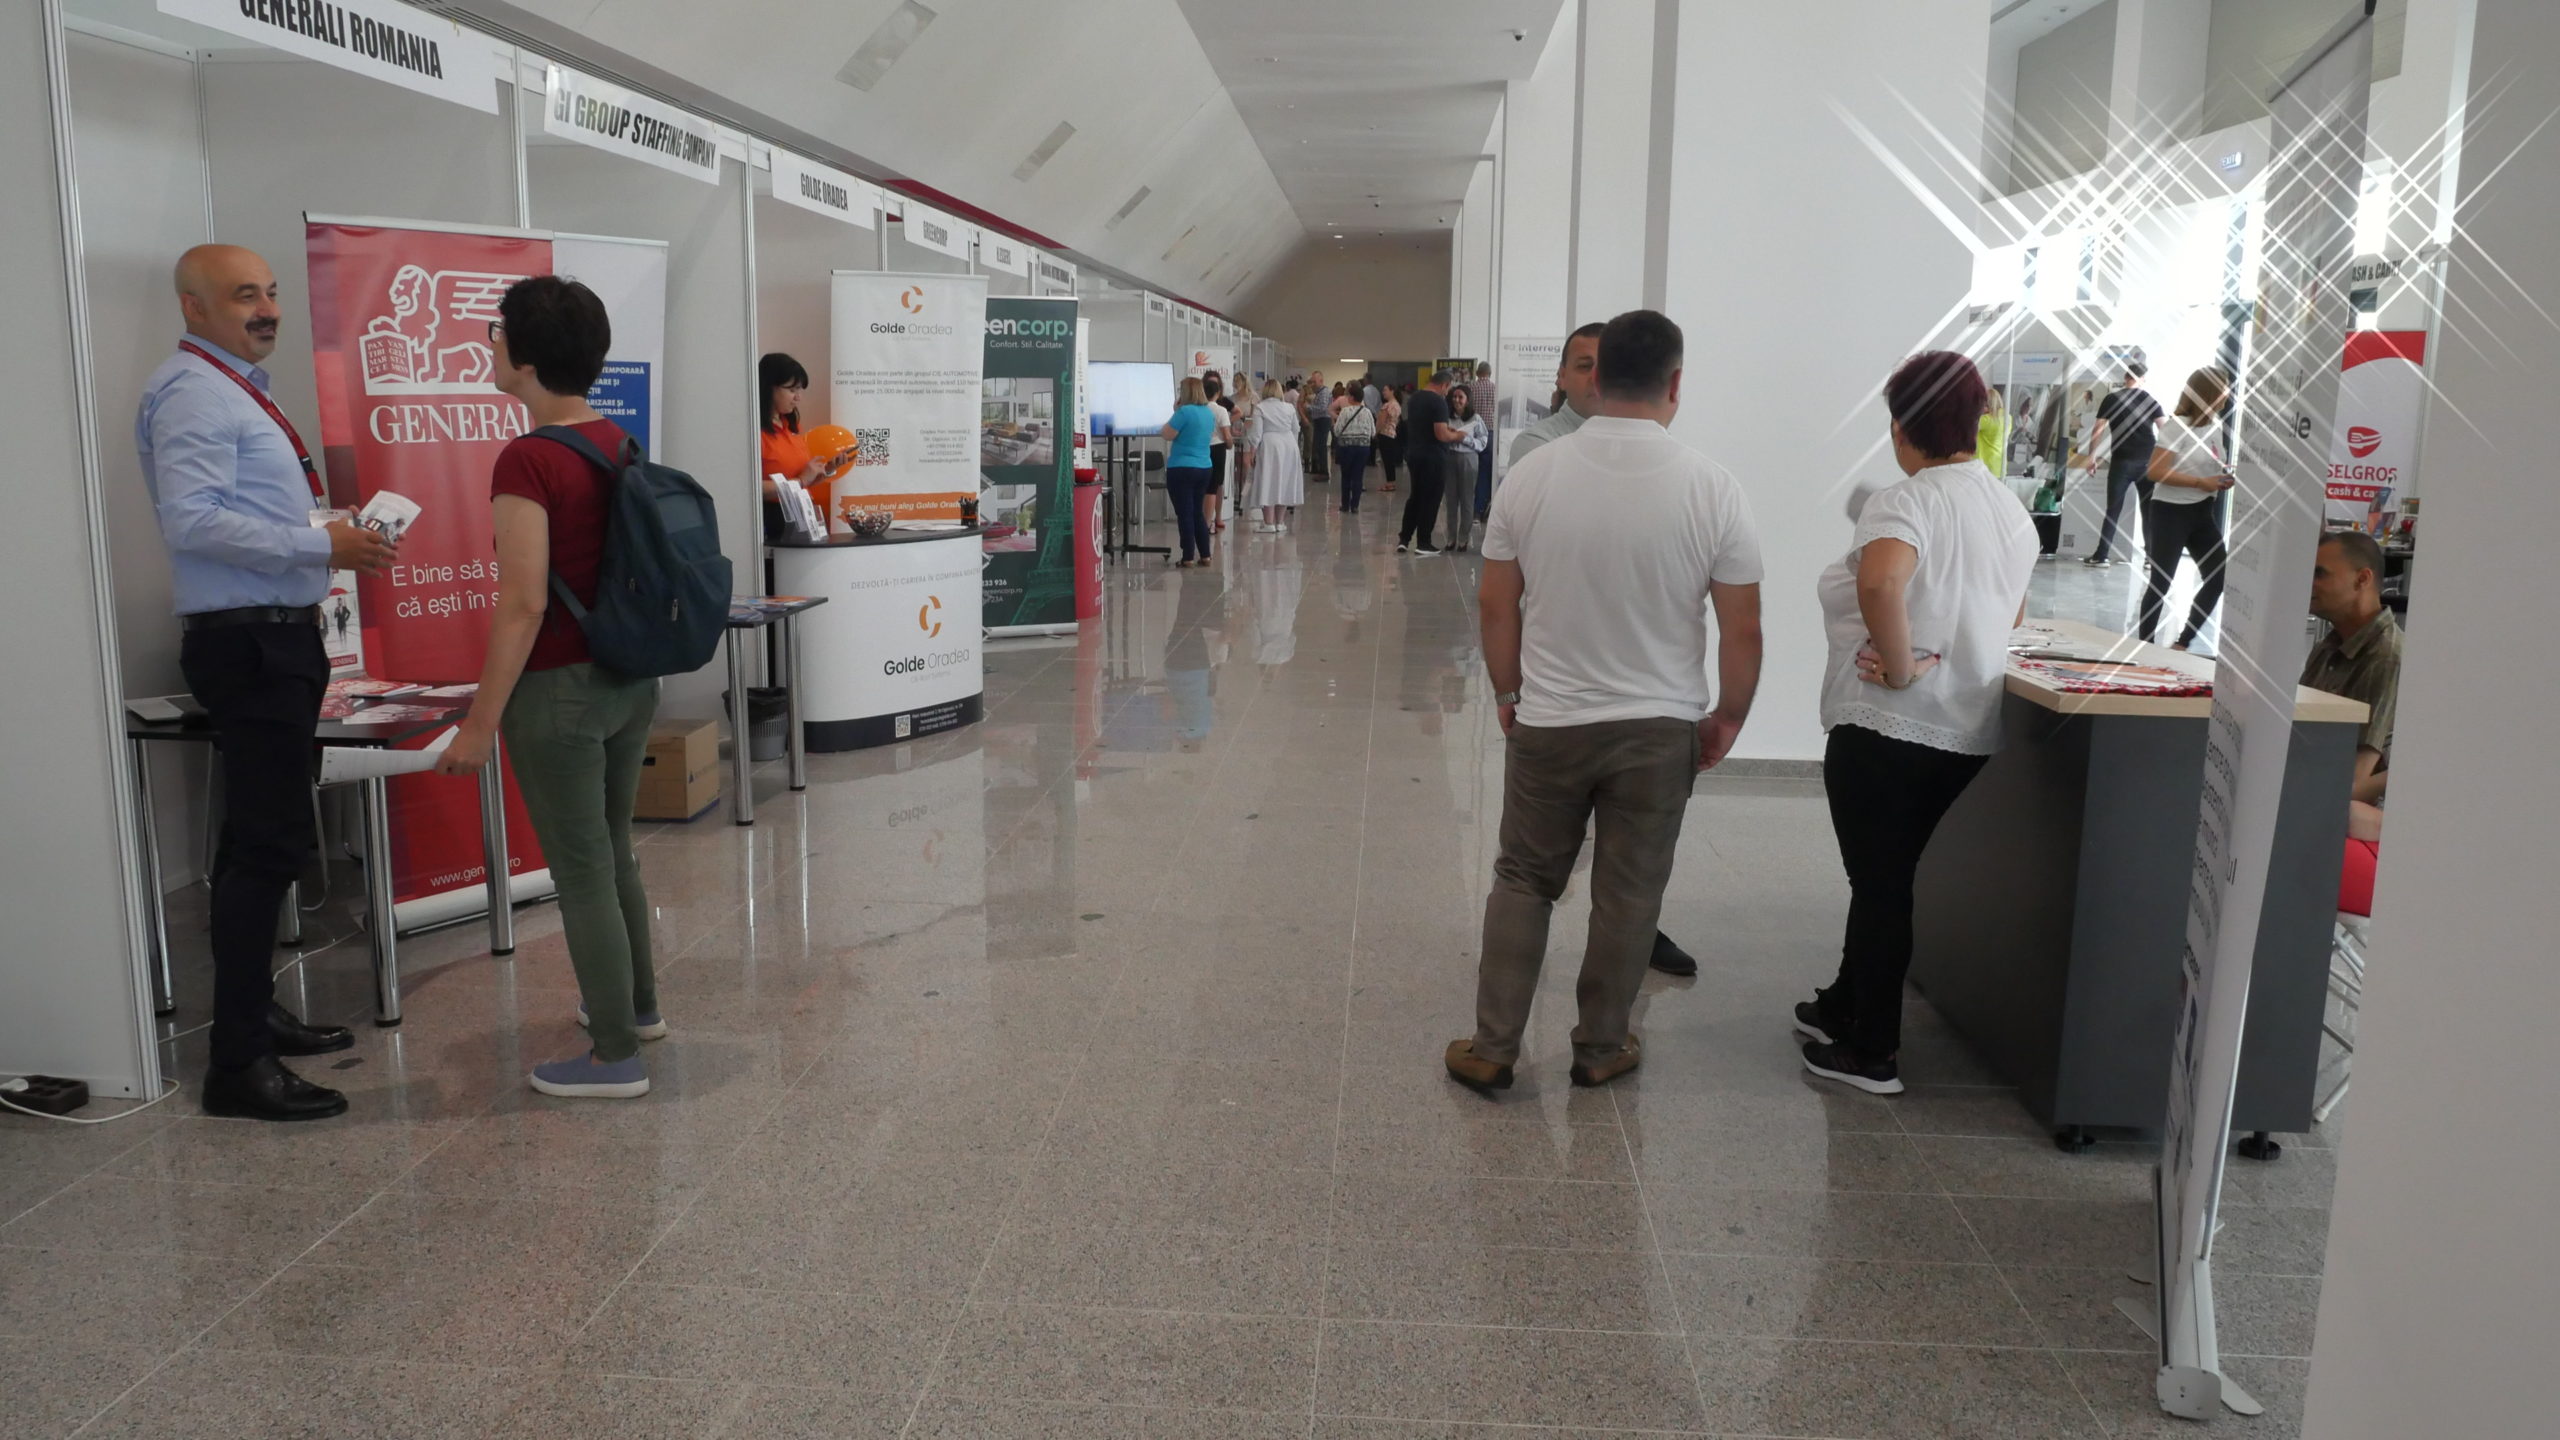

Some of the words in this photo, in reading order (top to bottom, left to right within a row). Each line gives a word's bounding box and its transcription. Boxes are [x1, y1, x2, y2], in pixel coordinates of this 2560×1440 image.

[349, 11, 443, 80] ROMANIA
[553, 87, 572, 123] GI
[574, 94, 631, 139] GROUP
[631, 113, 684, 158] STAFFING
[682, 131, 717, 170] COMPANY
[800, 172, 822, 202] GOLDE
[823, 181, 849, 211] ORADEA
[923, 220, 948, 247] GREENCORP
[2352, 265, 2368, 282] ASH
[870, 322, 905, 334] Golde
[908, 323, 953, 335] Oradea
[990, 340, 1019, 348] Confort.
[2327, 463, 2397, 481] SELGROS
[2328, 486, 2350, 496] cash
[2353, 486, 2361, 497] &
[391, 565, 407, 587] E
[412, 563, 453, 585] bine
[459, 558, 485, 580] să
[396, 596, 422, 618] că
[466, 590, 486, 609] în
[884, 655, 925, 676] Golde
[928, 648, 970, 669] Oradea
